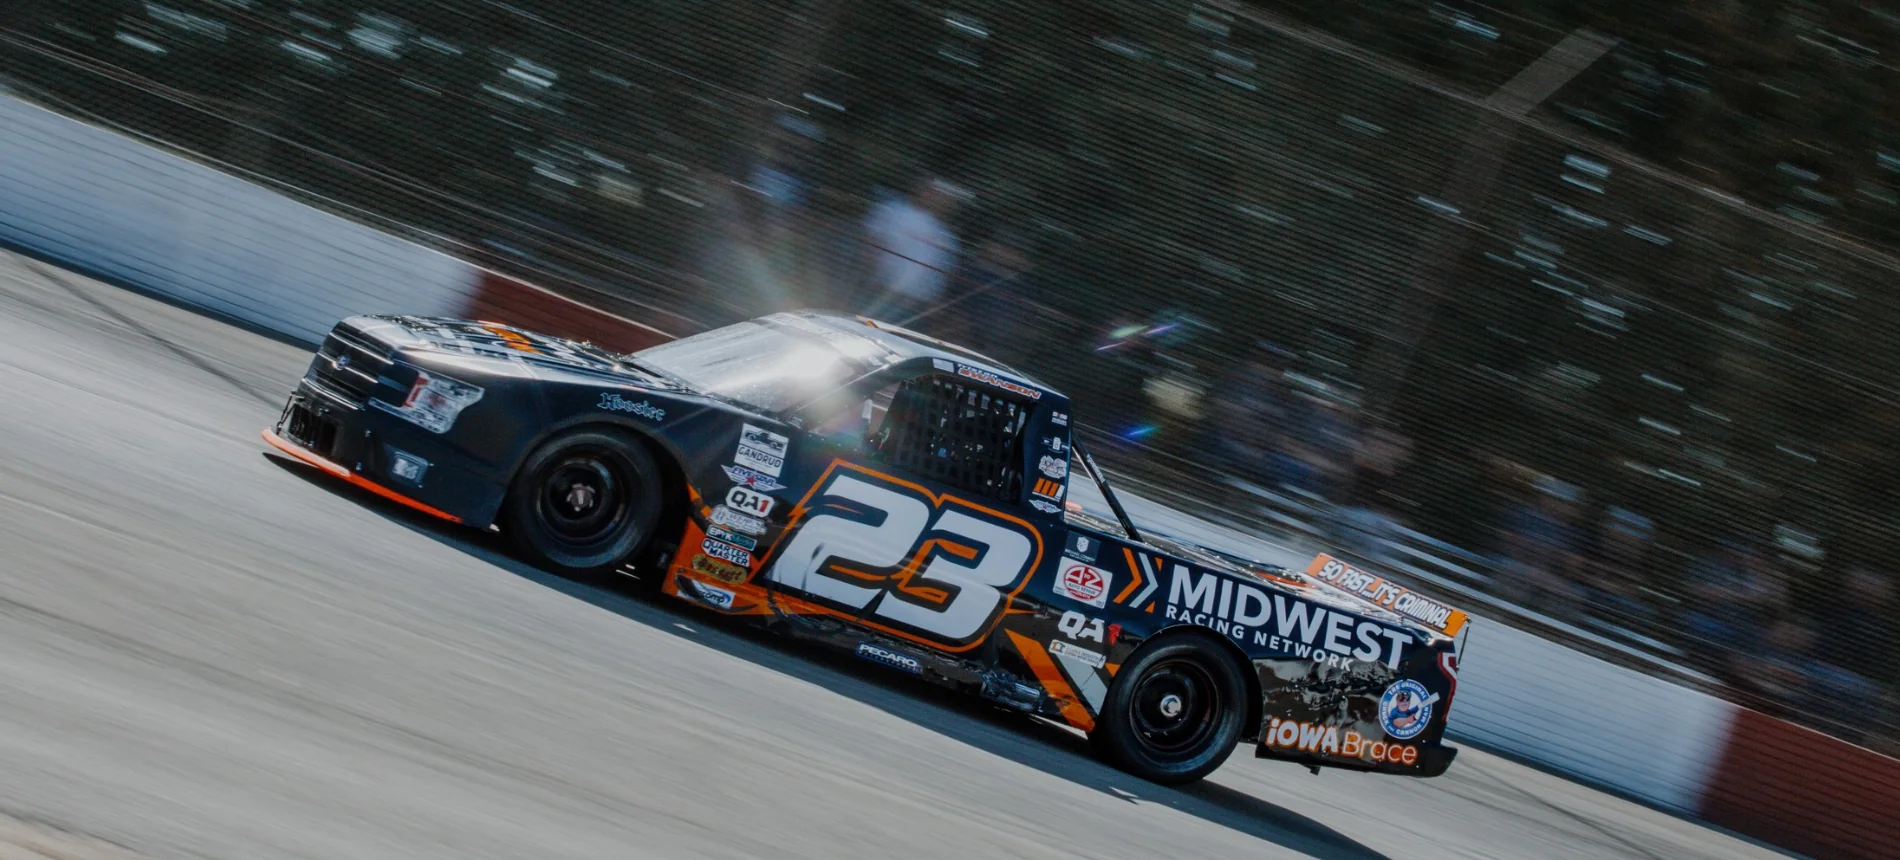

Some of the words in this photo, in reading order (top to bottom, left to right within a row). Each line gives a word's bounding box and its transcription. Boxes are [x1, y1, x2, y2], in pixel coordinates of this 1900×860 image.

[958, 368, 1042, 399] SWANSON
[738, 446, 782, 468] GANDRUD
[731, 490, 770, 513] QA1
[703, 539, 748, 559] QUARTER
[708, 547, 748, 566] MASTER
[765, 474, 1031, 639] 23
[1318, 560, 1345, 582] SO
[1394, 591, 1452, 630] CRIMINAL
[1057, 610, 1122, 647] QA1
[1168, 564, 1412, 670] MIDWEST
[1166, 604, 1244, 639] RACING
[1254, 631, 1353, 672] NETWORK
[859, 643, 918, 668] PECARO
[1401, 681, 1427, 700] ORIGINAL
[1396, 724, 1422, 735] CANNON
[1421, 706, 1429, 723] MAN
